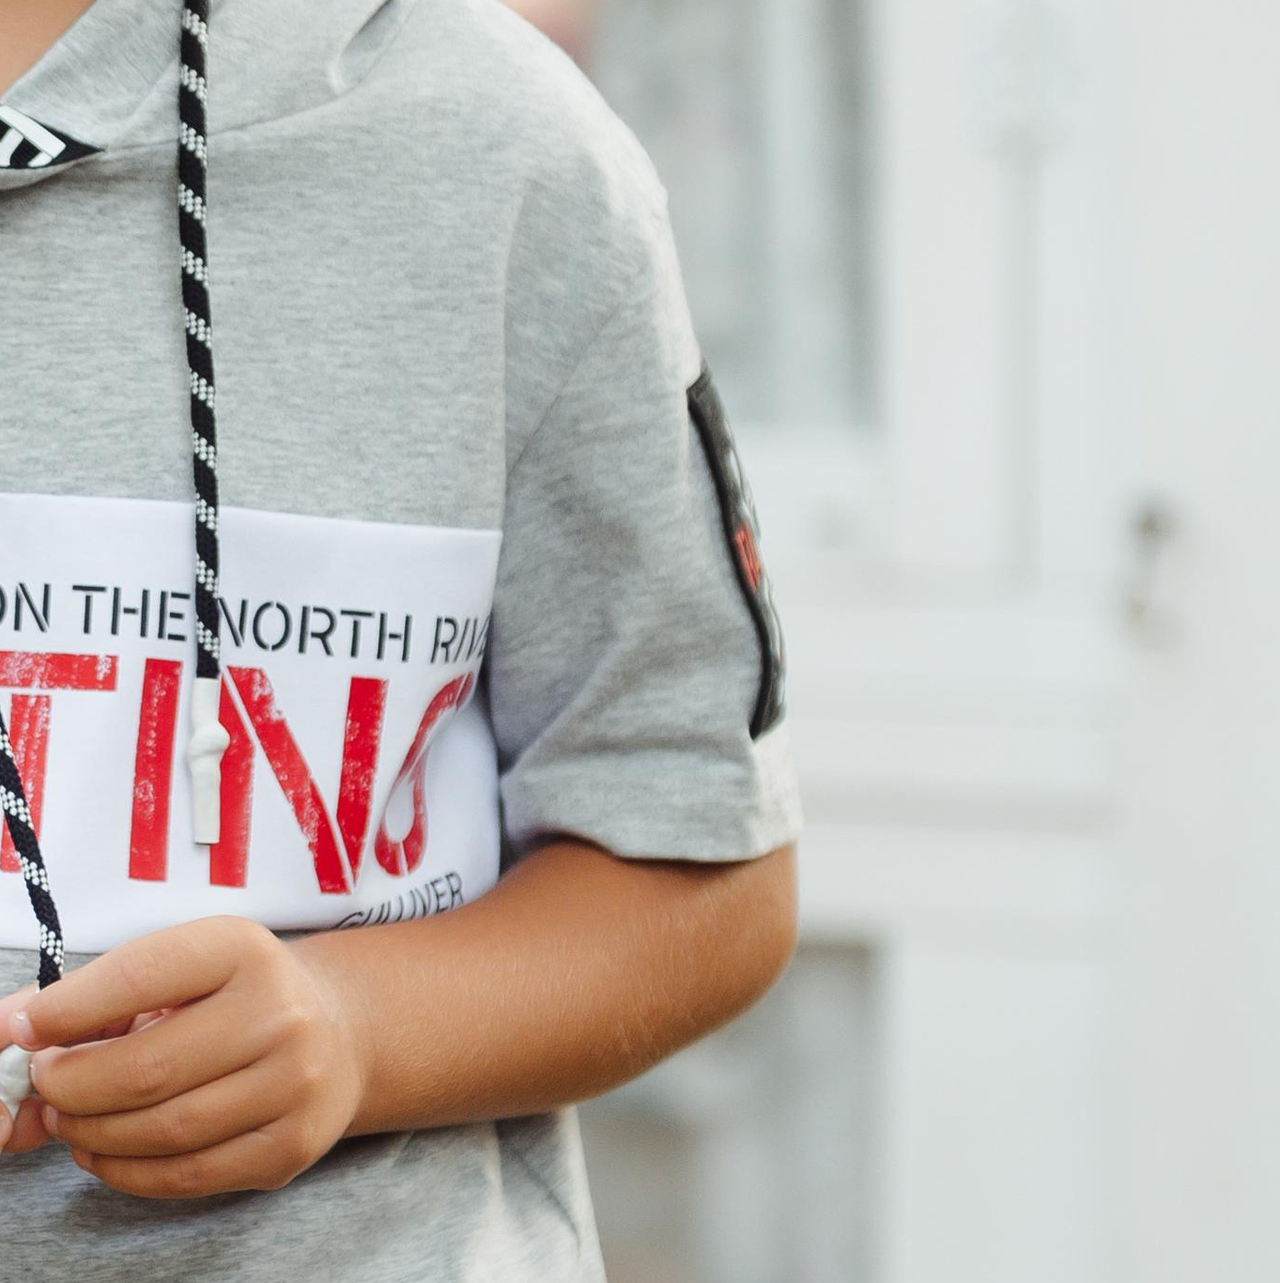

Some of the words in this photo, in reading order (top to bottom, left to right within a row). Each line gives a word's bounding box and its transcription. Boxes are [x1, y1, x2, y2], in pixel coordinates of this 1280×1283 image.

[72, 585, 191, 642] THE
[219, 597, 413, 663] NORTH
[430, 615, 490, 663] RIV
